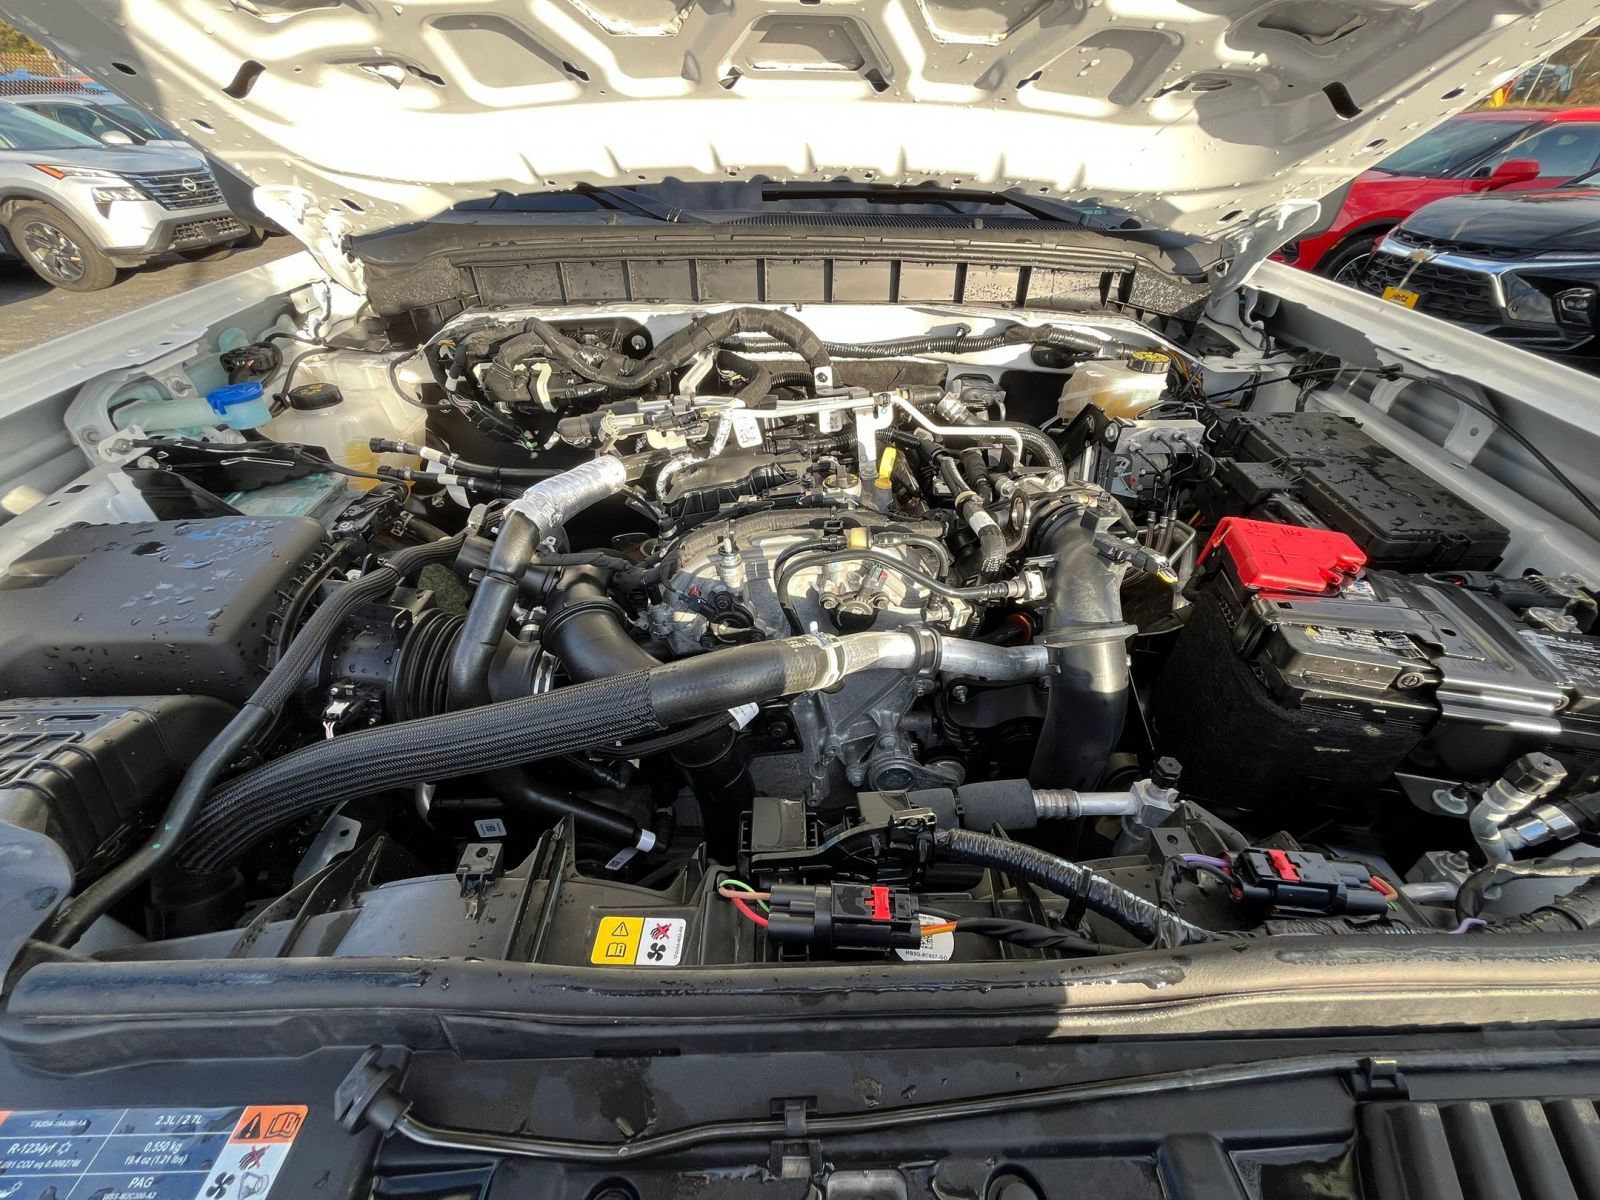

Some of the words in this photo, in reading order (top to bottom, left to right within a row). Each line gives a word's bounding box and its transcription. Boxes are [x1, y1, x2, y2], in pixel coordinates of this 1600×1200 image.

[155, 1115, 176, 1125] 2.3L
[7, 1142, 58, 1156] R-1234yf
[144, 1141, 170, 1153] 0.550
[169, 1141, 183, 1155] kg
[128, 1177, 155, 1189] PAG
